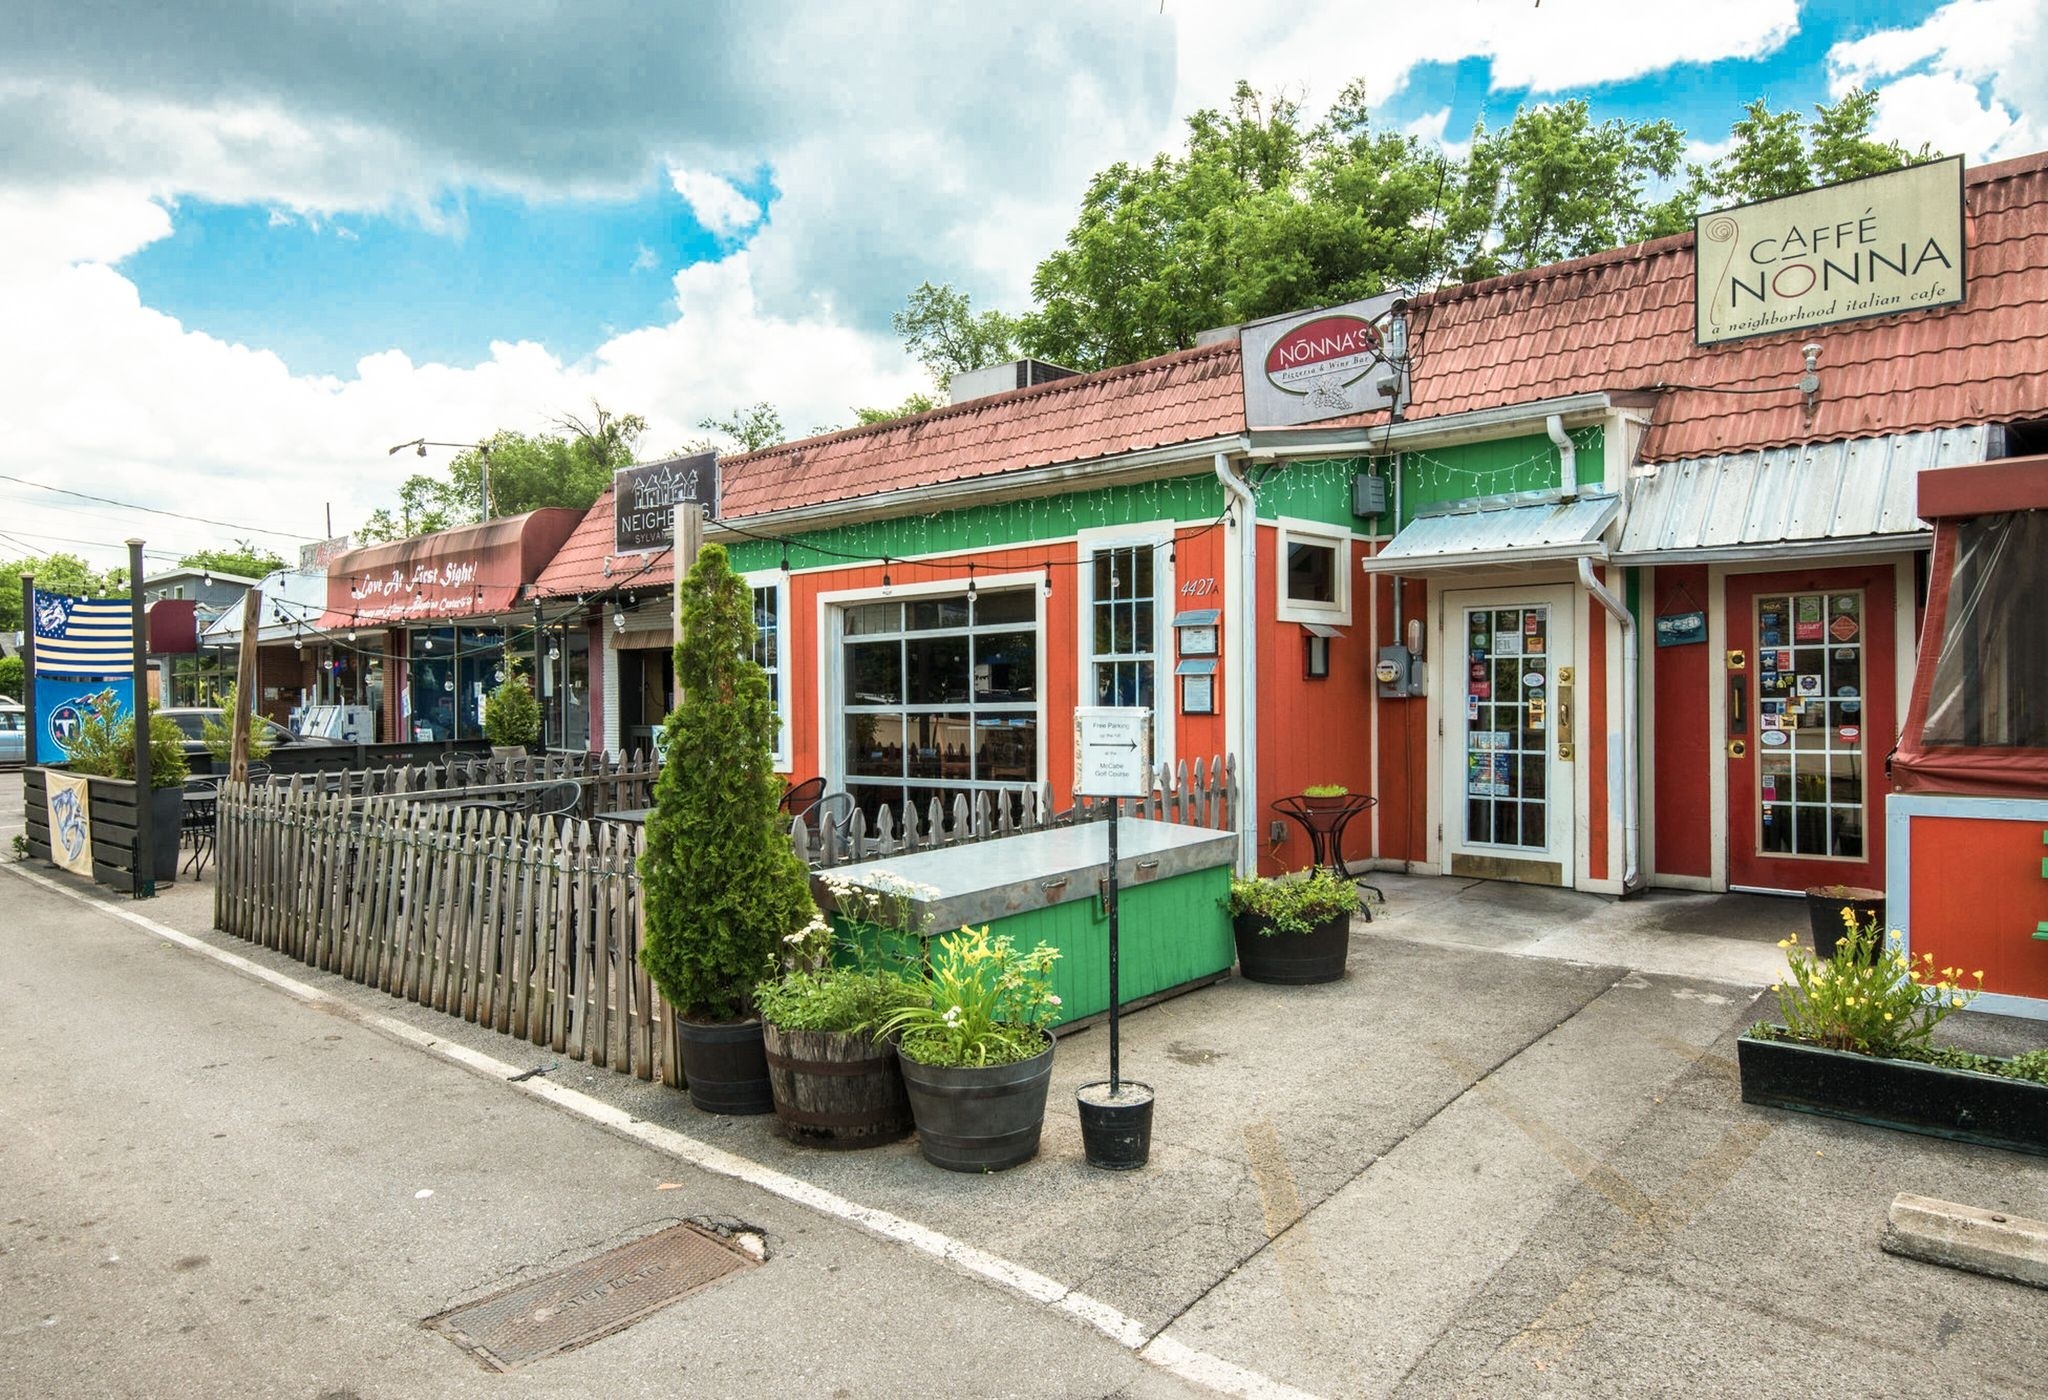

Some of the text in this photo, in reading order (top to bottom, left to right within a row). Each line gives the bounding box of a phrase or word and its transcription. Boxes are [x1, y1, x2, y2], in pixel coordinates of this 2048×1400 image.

[1749, 207, 1877, 265] CAFFÉ
[1731, 237, 1952, 308] NONNA
[1711, 281, 1946, 335] a neighborhood italian cafe
[1282, 356, 1369, 380] Pizzeria & Wine Bar
[621, 502, 710, 533] NEIGHBS
[354, 561, 478, 599] Love At First Sight!
[1107, 722, 1130, 730] Parking
